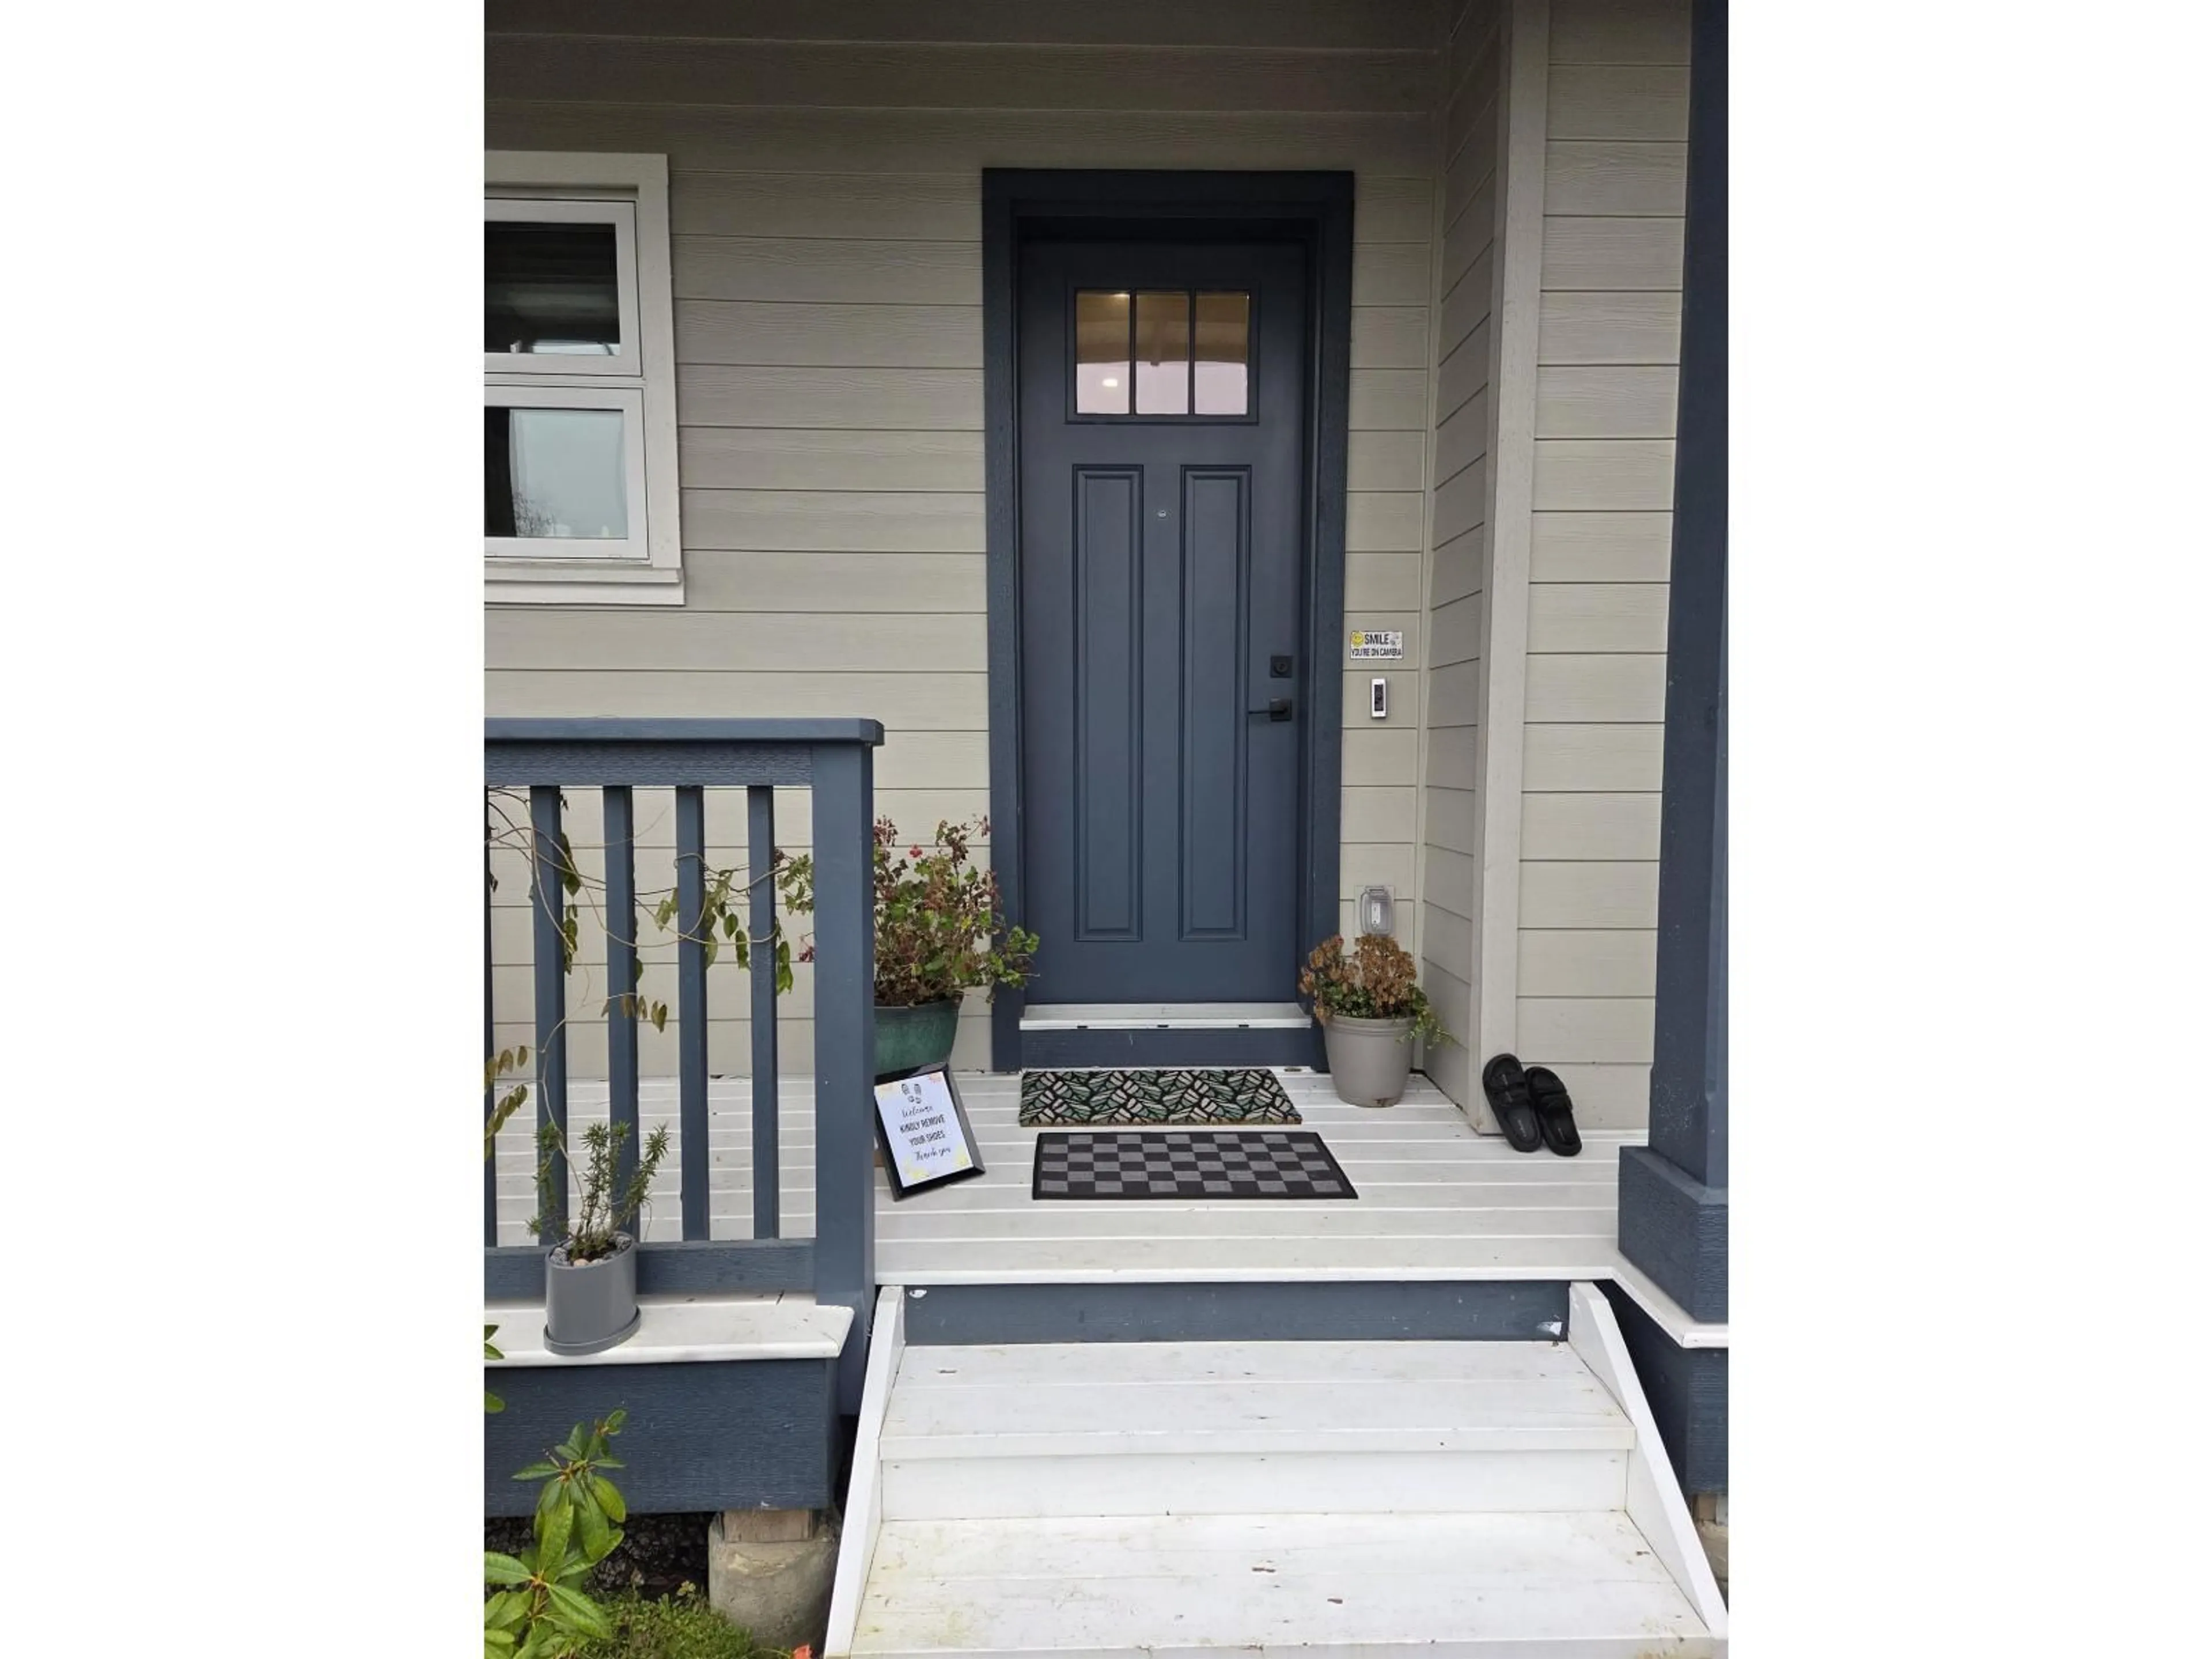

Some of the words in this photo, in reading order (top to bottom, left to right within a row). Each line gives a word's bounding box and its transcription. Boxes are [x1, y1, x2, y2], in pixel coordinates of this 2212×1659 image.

[1365, 633, 1389, 645] SMILE
[1371, 647, 1379, 656] ON
[1380, 647, 1402, 656] CAMERA
[902, 1105, 933, 1118] Welcome
[900, 1121, 921, 1134] KINDLY
[921, 1114, 945, 1127] REMOVE
[908, 1135, 925, 1146] YOUR
[926, 1130, 945, 1142] SHOES
[914, 1147, 937, 1161] Thank
[938, 1147, 951, 1157] you
